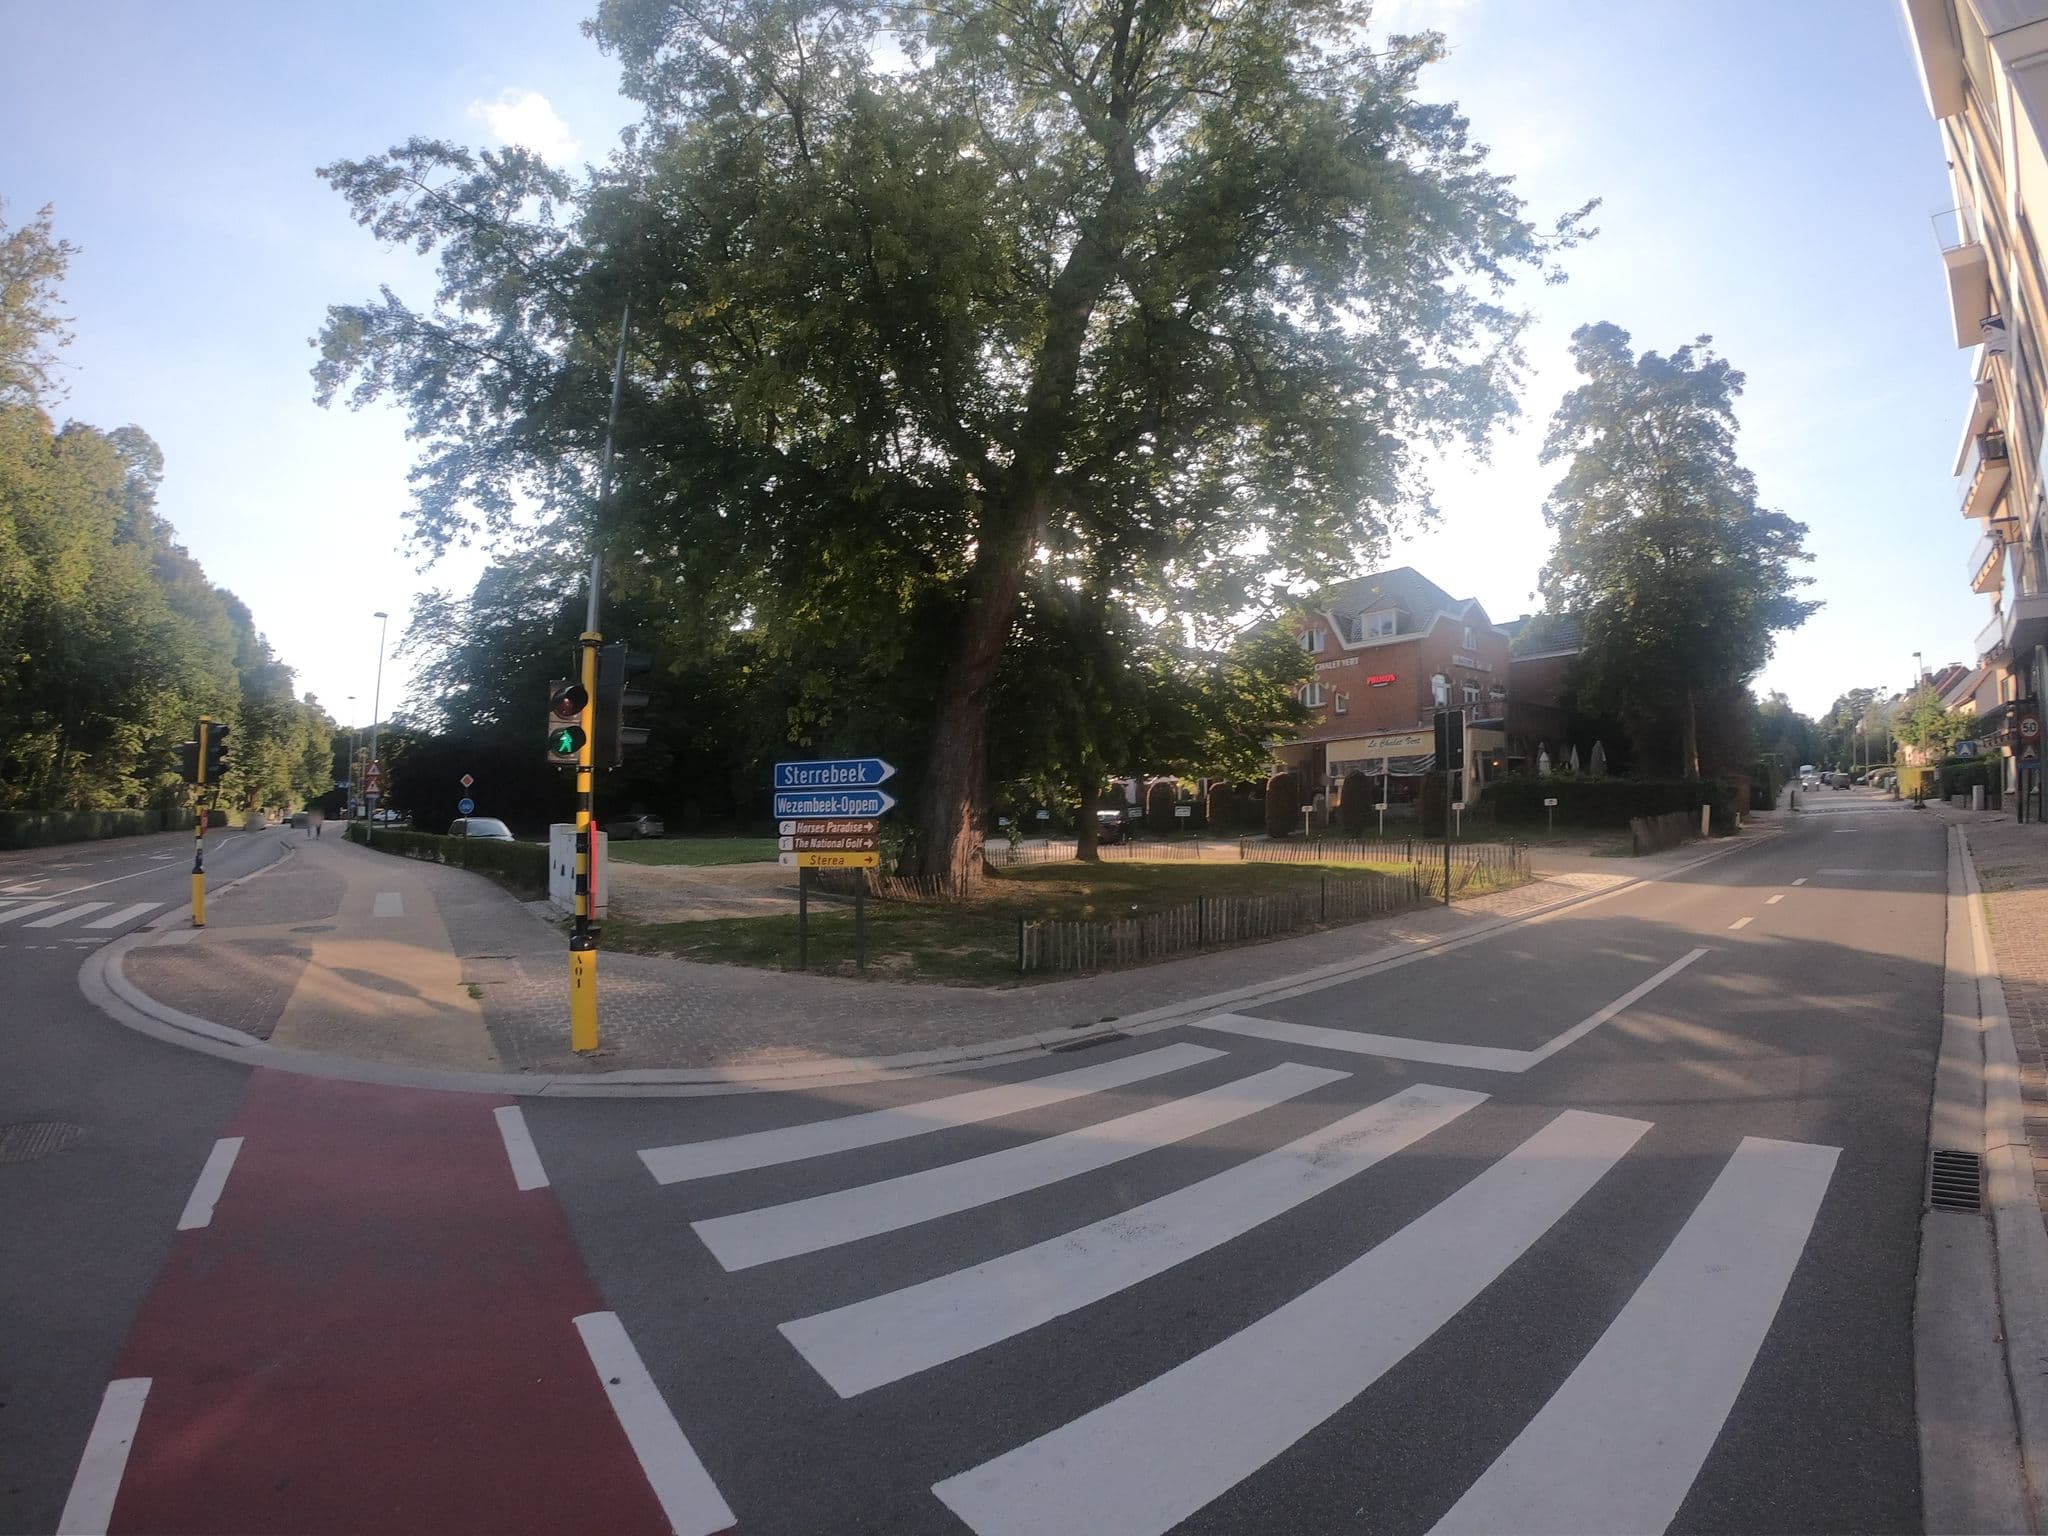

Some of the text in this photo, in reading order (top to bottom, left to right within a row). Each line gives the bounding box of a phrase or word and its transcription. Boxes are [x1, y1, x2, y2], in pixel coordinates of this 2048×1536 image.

[784, 763, 866, 785] Sterrebeek
[777, 795, 879, 815] Wezembeek-Oppem
[797, 821, 864, 833] Horses Paradise
[795, 838, 864, 848] The National Golf
[810, 855, 845, 865] Sterea
